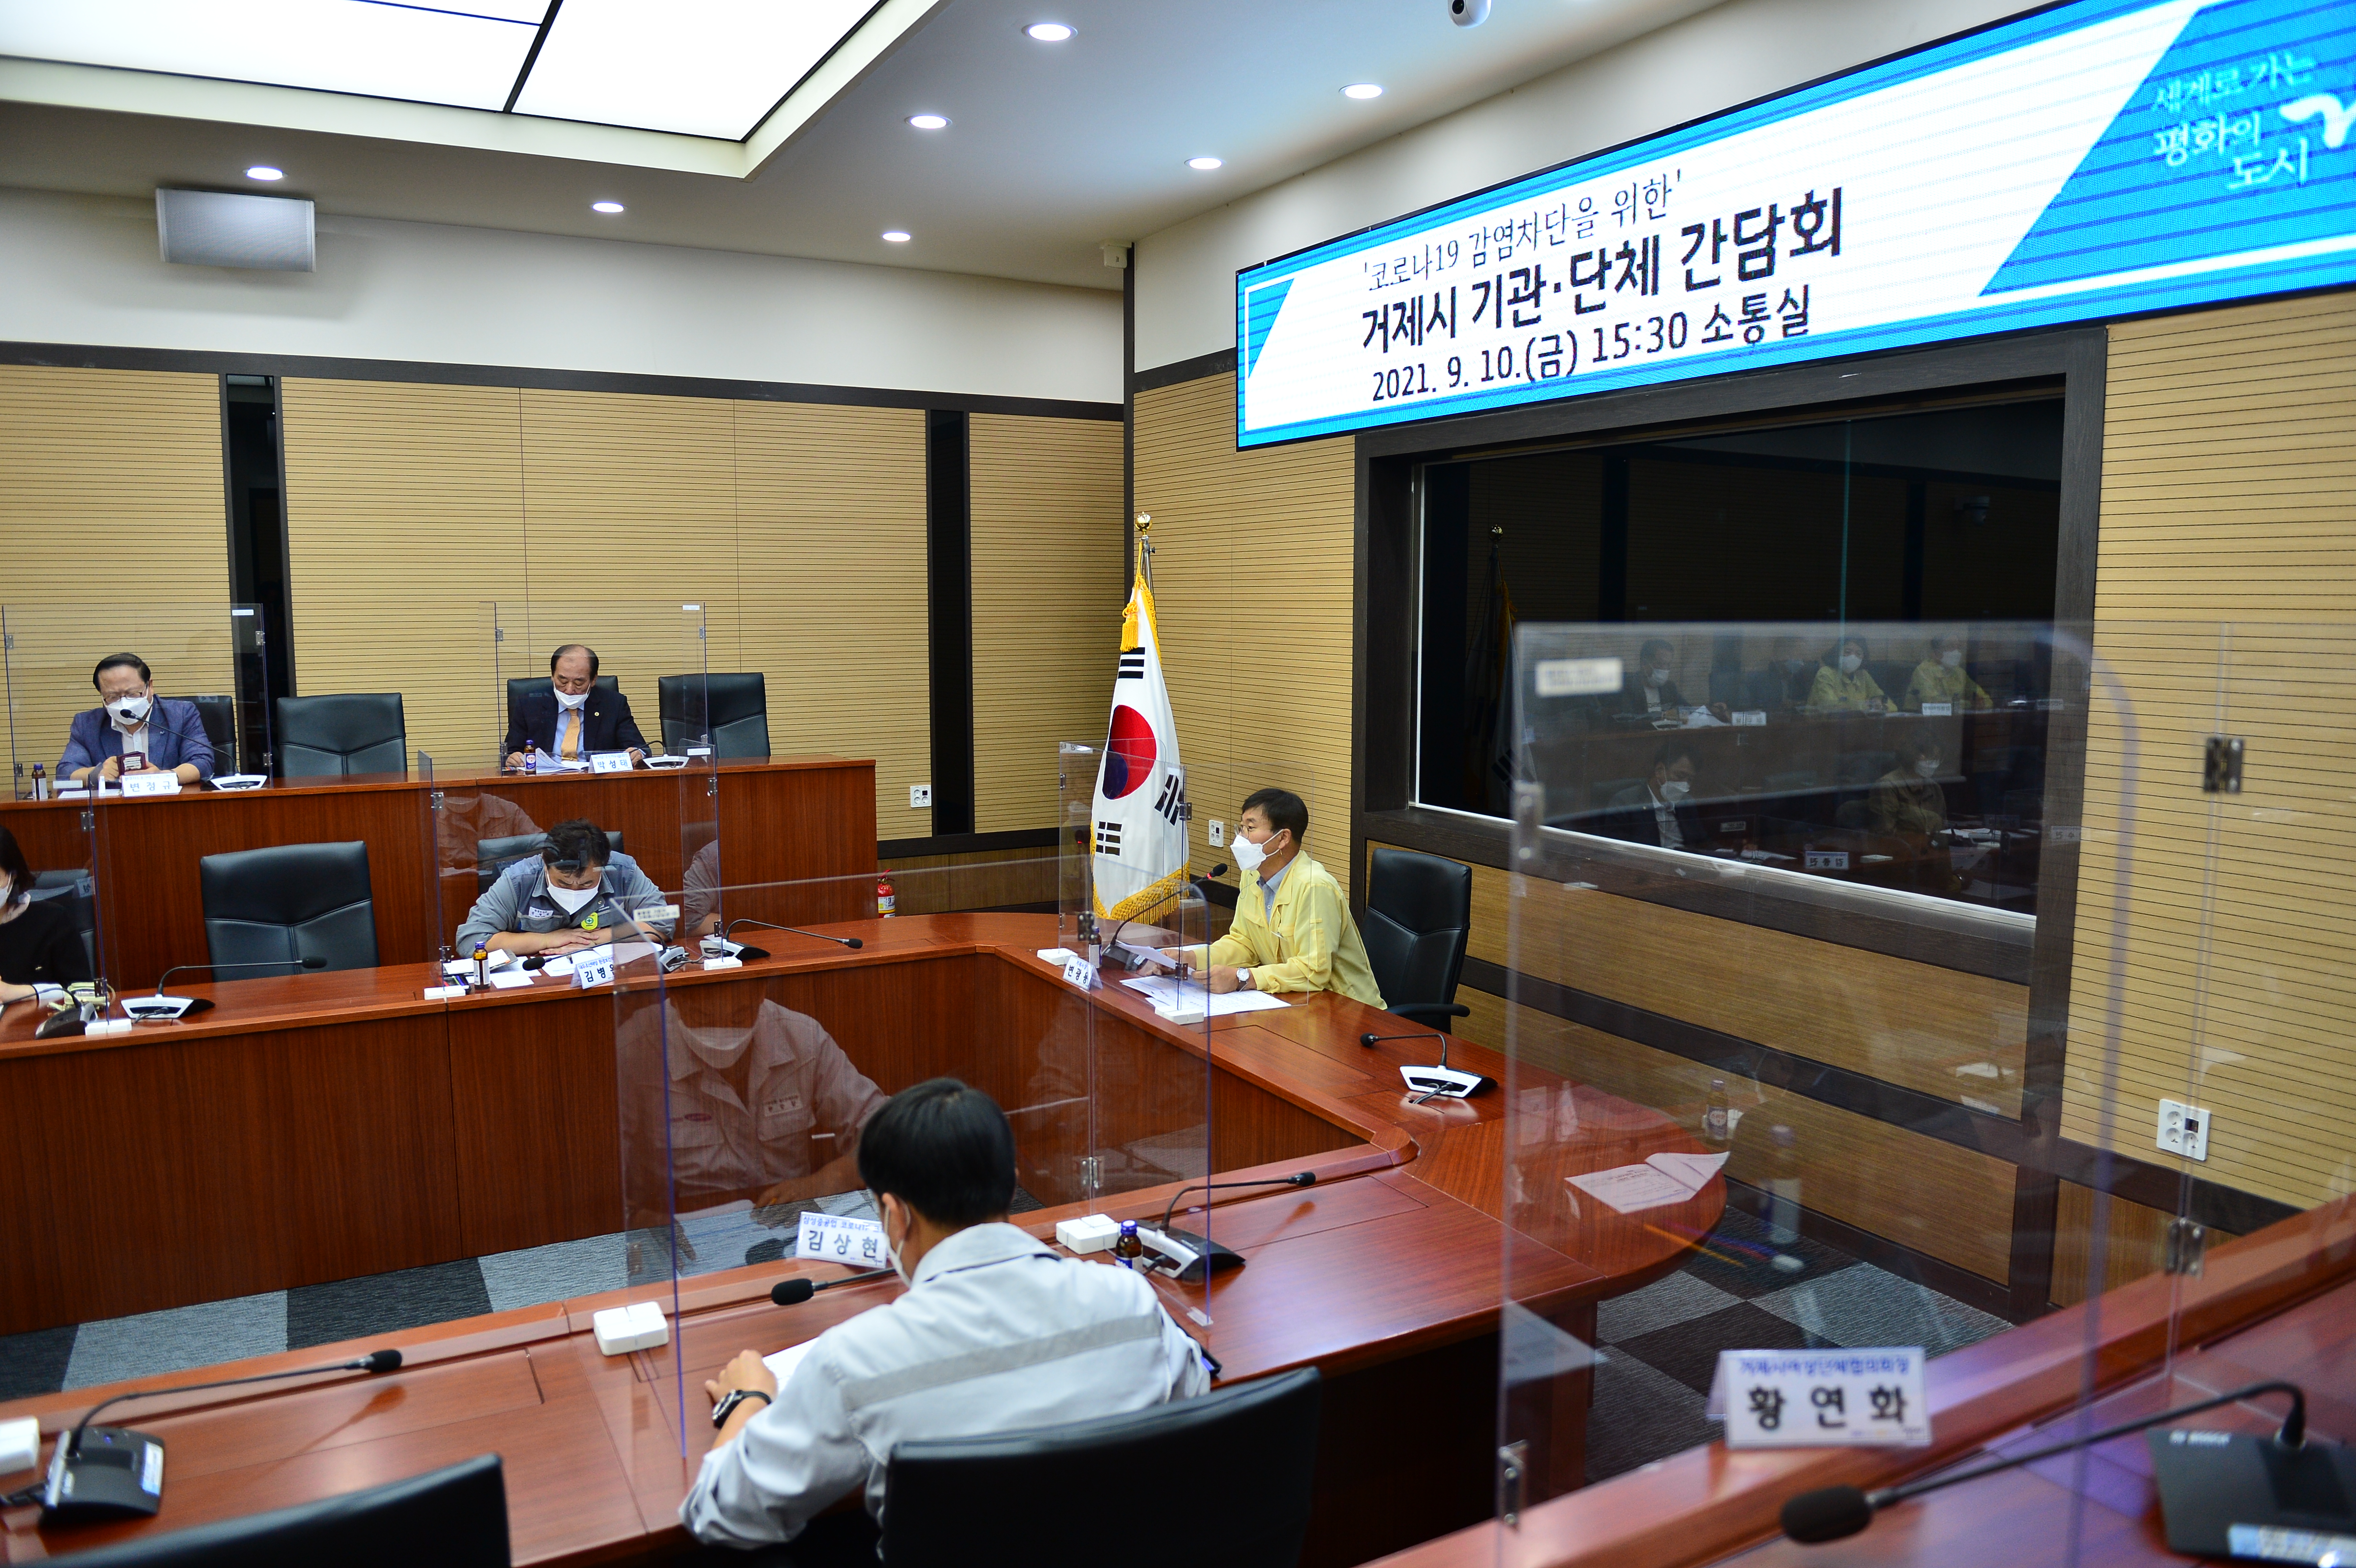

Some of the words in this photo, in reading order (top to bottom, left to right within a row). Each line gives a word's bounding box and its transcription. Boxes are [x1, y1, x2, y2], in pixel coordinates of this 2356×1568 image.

[2155, 66, 2245, 113] 세계로
[2249, 50, 2316, 90] 가는
[2153, 110, 2261, 167] 평화의
[2226, 137, 2308, 190] 도시
[1469, 197, 1599, 269] 감염차단을
[1611, 168, 1681, 228] 위한'
[1362, 286, 1456, 353] 거제시
[1681, 186, 1843, 293] 간담회
[1372, 363, 1436, 402] 2021.
[1447, 356, 1469, 388] 9.
[1592, 311, 1688, 363] 15:30
[1701, 284, 1809, 345] 소통실
